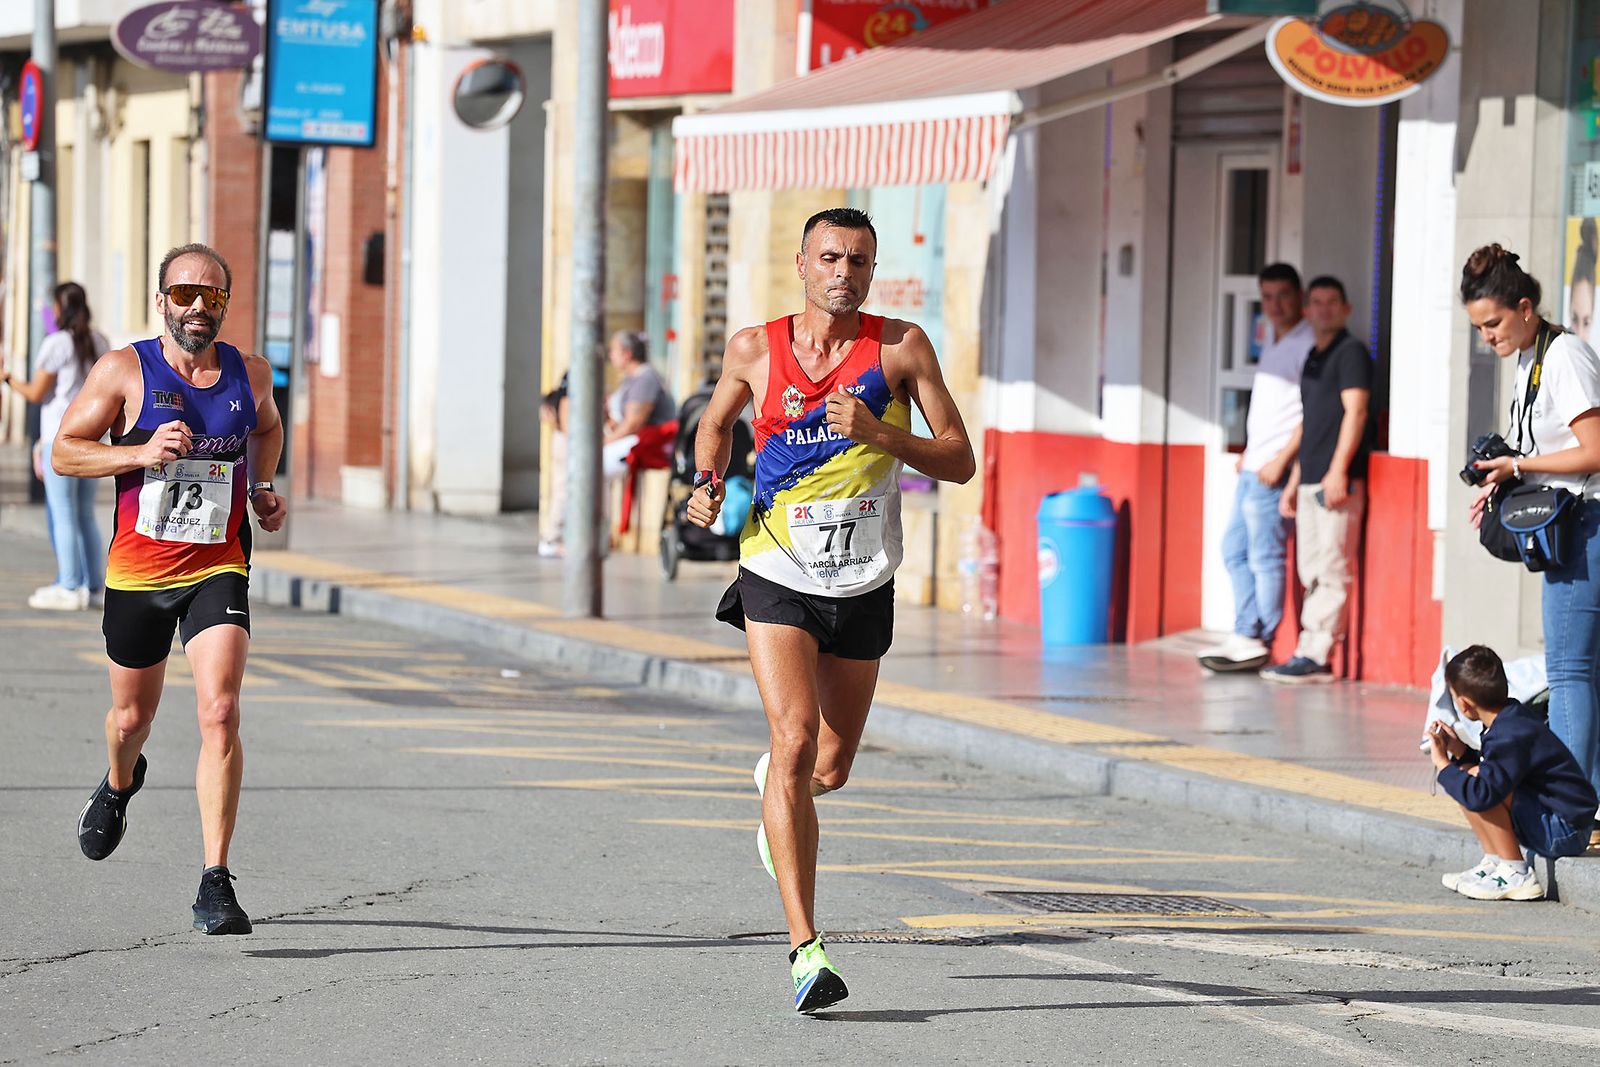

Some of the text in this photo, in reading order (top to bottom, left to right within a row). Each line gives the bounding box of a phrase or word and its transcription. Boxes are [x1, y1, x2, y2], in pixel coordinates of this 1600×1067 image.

[874, 11, 906, 34] 24
[1295, 35, 1428, 81] POLVILLO
[168, 482, 203, 510] 13
[160, 515, 201, 526] VAZQUEZ
[819, 521, 856, 553] 77
[837, 555, 874, 567] ARRIAZA
